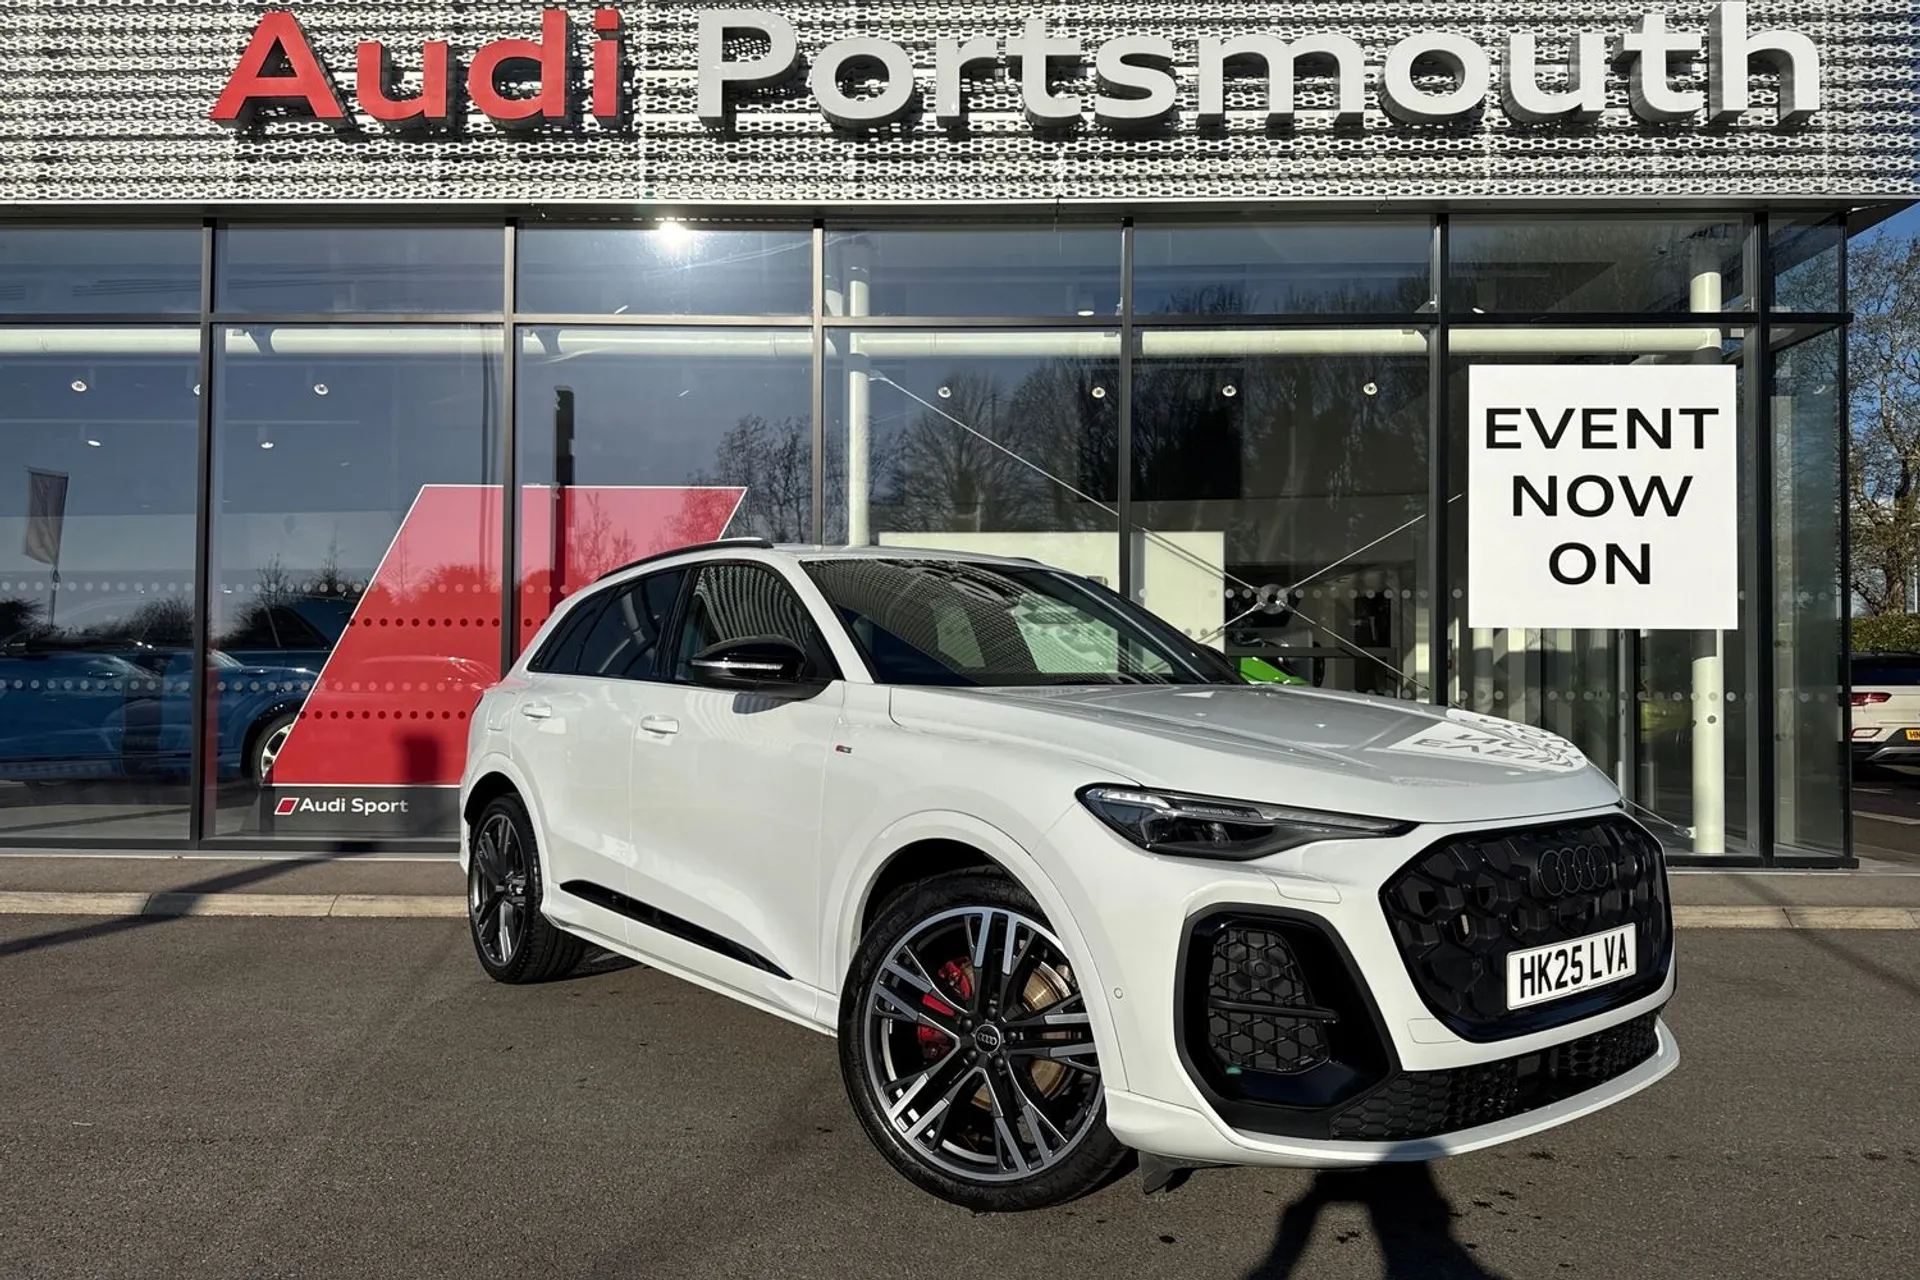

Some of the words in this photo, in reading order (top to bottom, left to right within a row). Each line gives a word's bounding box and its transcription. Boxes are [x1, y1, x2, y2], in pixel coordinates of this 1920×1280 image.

[209, 8, 620, 122] Audi
[697, 0, 1821, 125] Portsmouth
[1486, 408, 1719, 449] EVENT
[1512, 474, 1694, 518] NOW
[1548, 541, 1651, 585] ON
[299, 797, 347, 813] Audi
[351, 797, 409, 817] Sport
[1519, 943, 1584, 999] HK25
[1589, 932, 1629, 980] LVA
